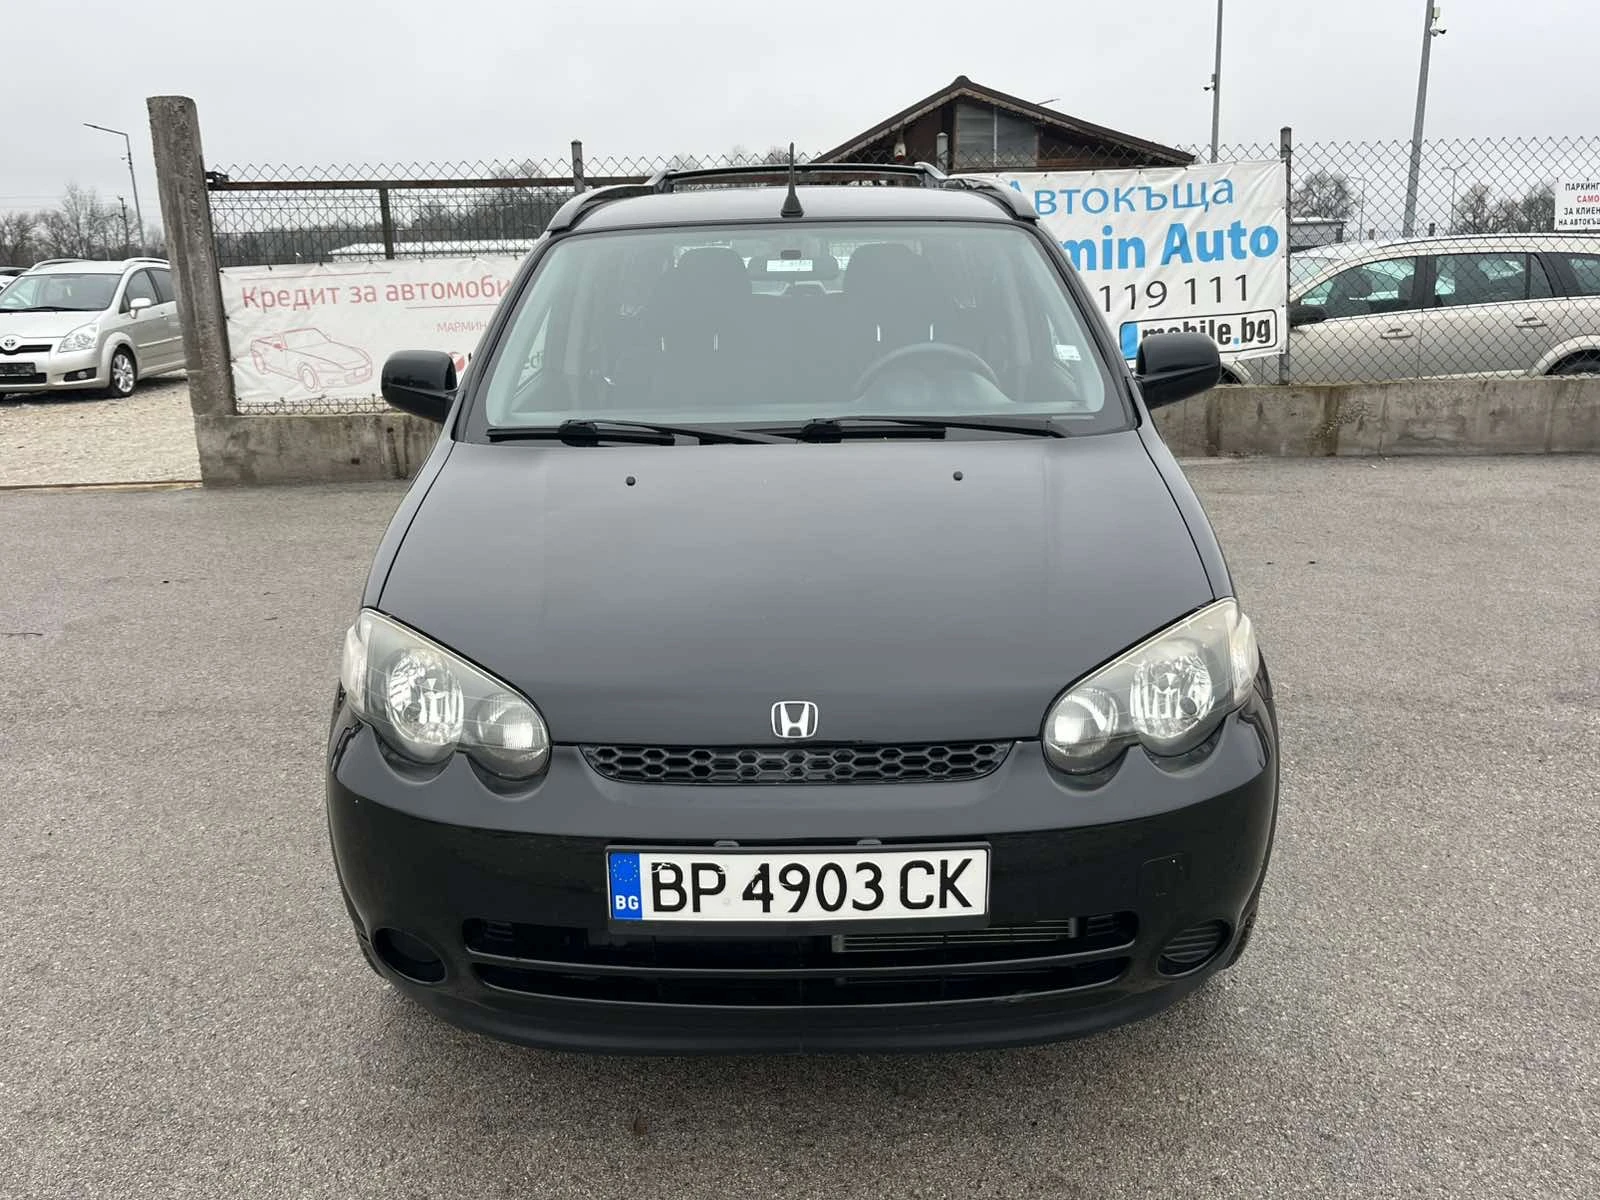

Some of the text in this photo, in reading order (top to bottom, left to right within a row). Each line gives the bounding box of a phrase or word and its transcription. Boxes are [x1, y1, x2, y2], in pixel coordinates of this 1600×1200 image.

[1565, 182, 1600, 191] ПАРКИНГ
[1576, 194, 1600, 203] САМО
[1564, 207, 1574, 215] ЗА
[1160, 219, 1280, 266] Auto
[241, 285, 341, 313] Кредит
[349, 284, 377, 304] за
[1099, 274, 1248, 313] 119 111
[651, 858, 972, 912] BP 4903 CK
[615, 895, 639, 911] BG
